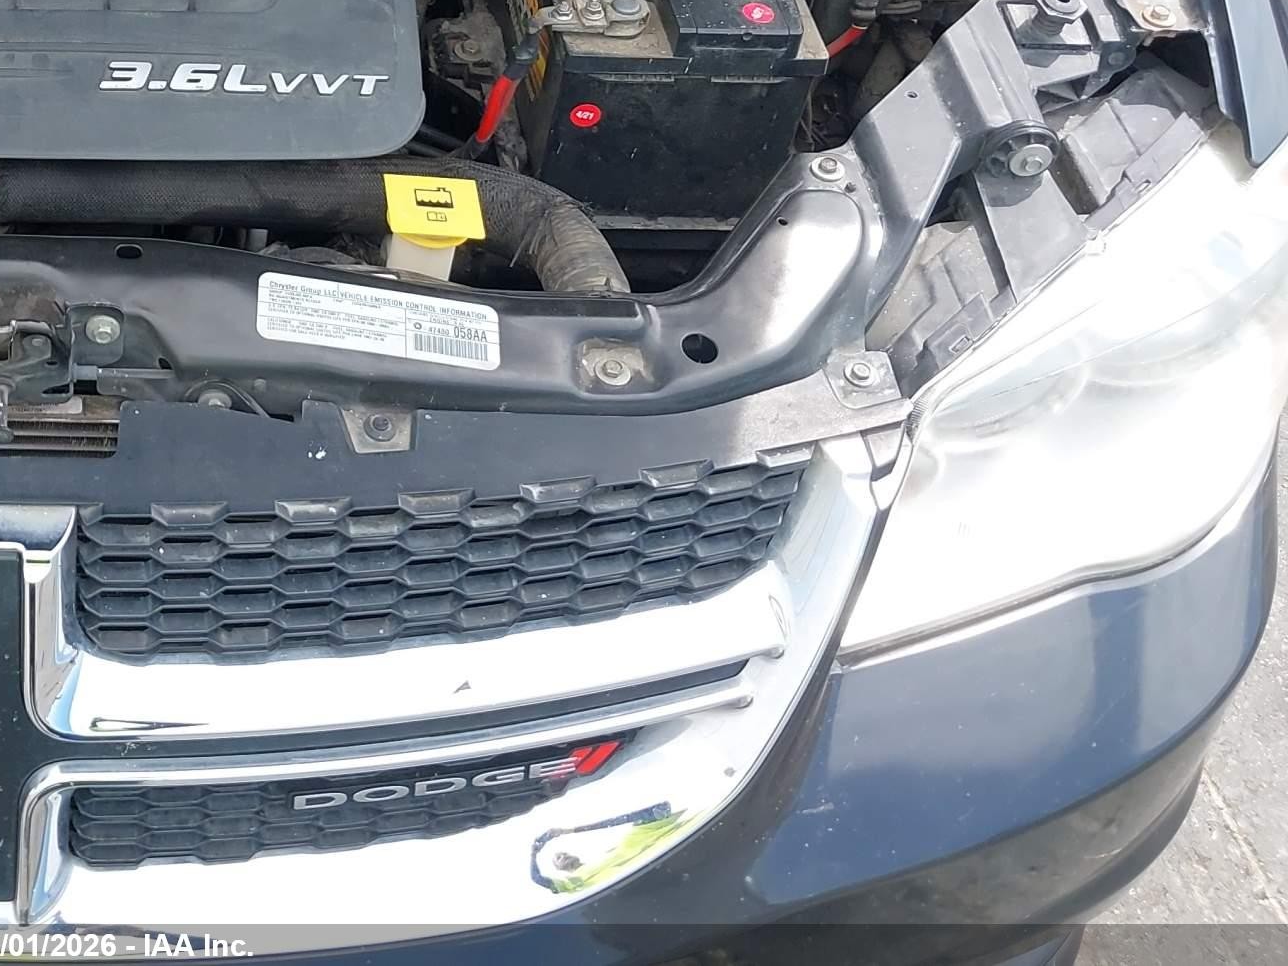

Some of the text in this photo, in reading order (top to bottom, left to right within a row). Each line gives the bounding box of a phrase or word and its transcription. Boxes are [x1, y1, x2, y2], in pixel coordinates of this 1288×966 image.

[269, 280, 298, 291] Chrysler
[300, 285, 322, 296] Group
[324, 288, 337, 297] LLC
[340, 291, 368, 301] VEHICLE
[370, 294, 403, 307] EMISSION
[405, 301, 437, 312] CONTROL
[439, 307, 487, 320] INFORMATION
[453, 326, 488, 342] 058AA
[293, 755, 581, 811] DODGE
